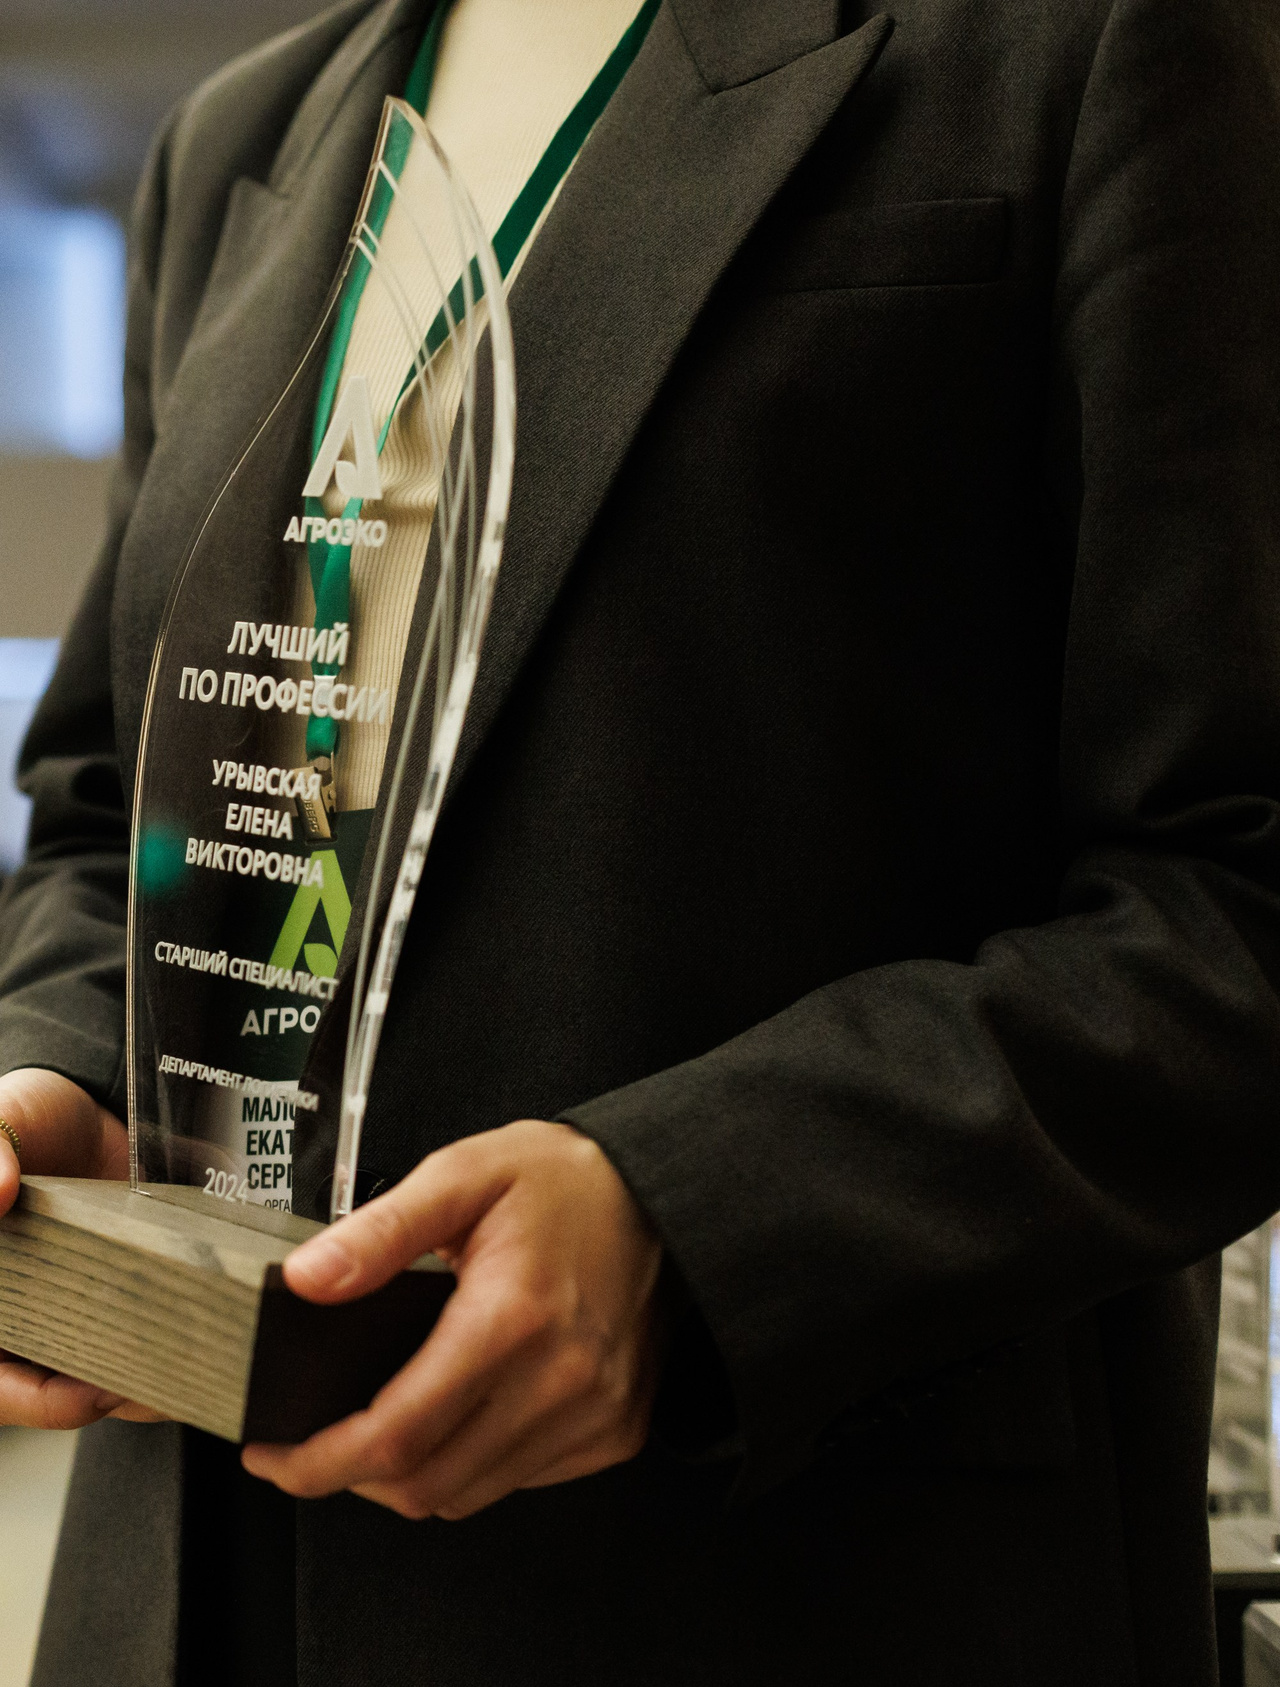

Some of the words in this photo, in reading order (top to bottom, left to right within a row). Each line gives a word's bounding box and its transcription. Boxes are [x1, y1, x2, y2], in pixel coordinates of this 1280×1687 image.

[283, 516, 388, 547] АГРОЭКО
[227, 620, 350, 665] ЛУЧШИЙ
[179, 667, 218, 703] ПО
[221, 672, 390, 724] ПРОФЕССИИ
[212, 759, 322, 800] УРЫВСКАЯ
[225, 803, 293, 840] ЕЛЕНА
[185, 838, 324, 889] ВИКТОРОВНА
[154, 941, 228, 977] СТАРШИЙ
[229, 958, 339, 1001] СПЕЦИАЛИСТ
[240, 1005, 320, 1036] АГРО
[159, 1055, 244, 1090] ДЕПАРТАМЕНТ
[203, 1167, 249, 1205] 2024
